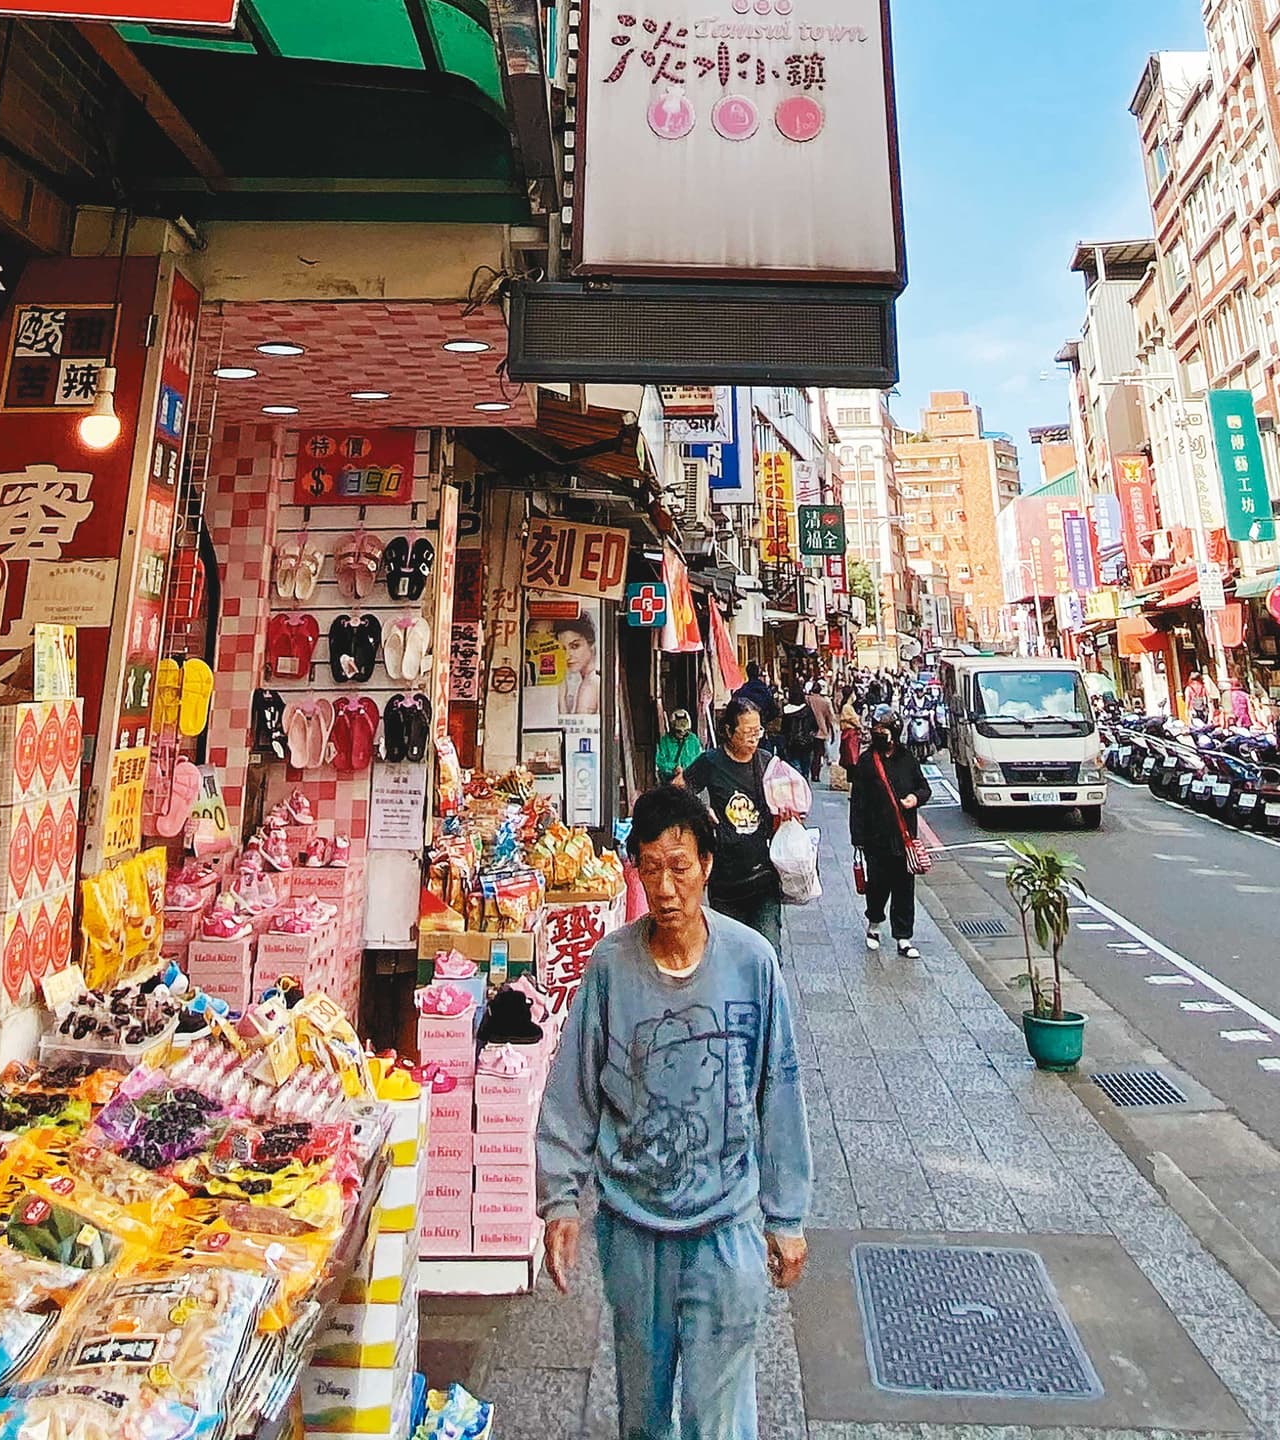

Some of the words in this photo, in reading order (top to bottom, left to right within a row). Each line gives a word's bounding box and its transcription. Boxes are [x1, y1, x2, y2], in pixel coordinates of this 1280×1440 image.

[603, 13, 827, 91] 淡水小鎮
[798, 23, 869, 43] town
[526, 525, 625, 592] 刻印
[435, 1185, 462, 1199] Kitty
